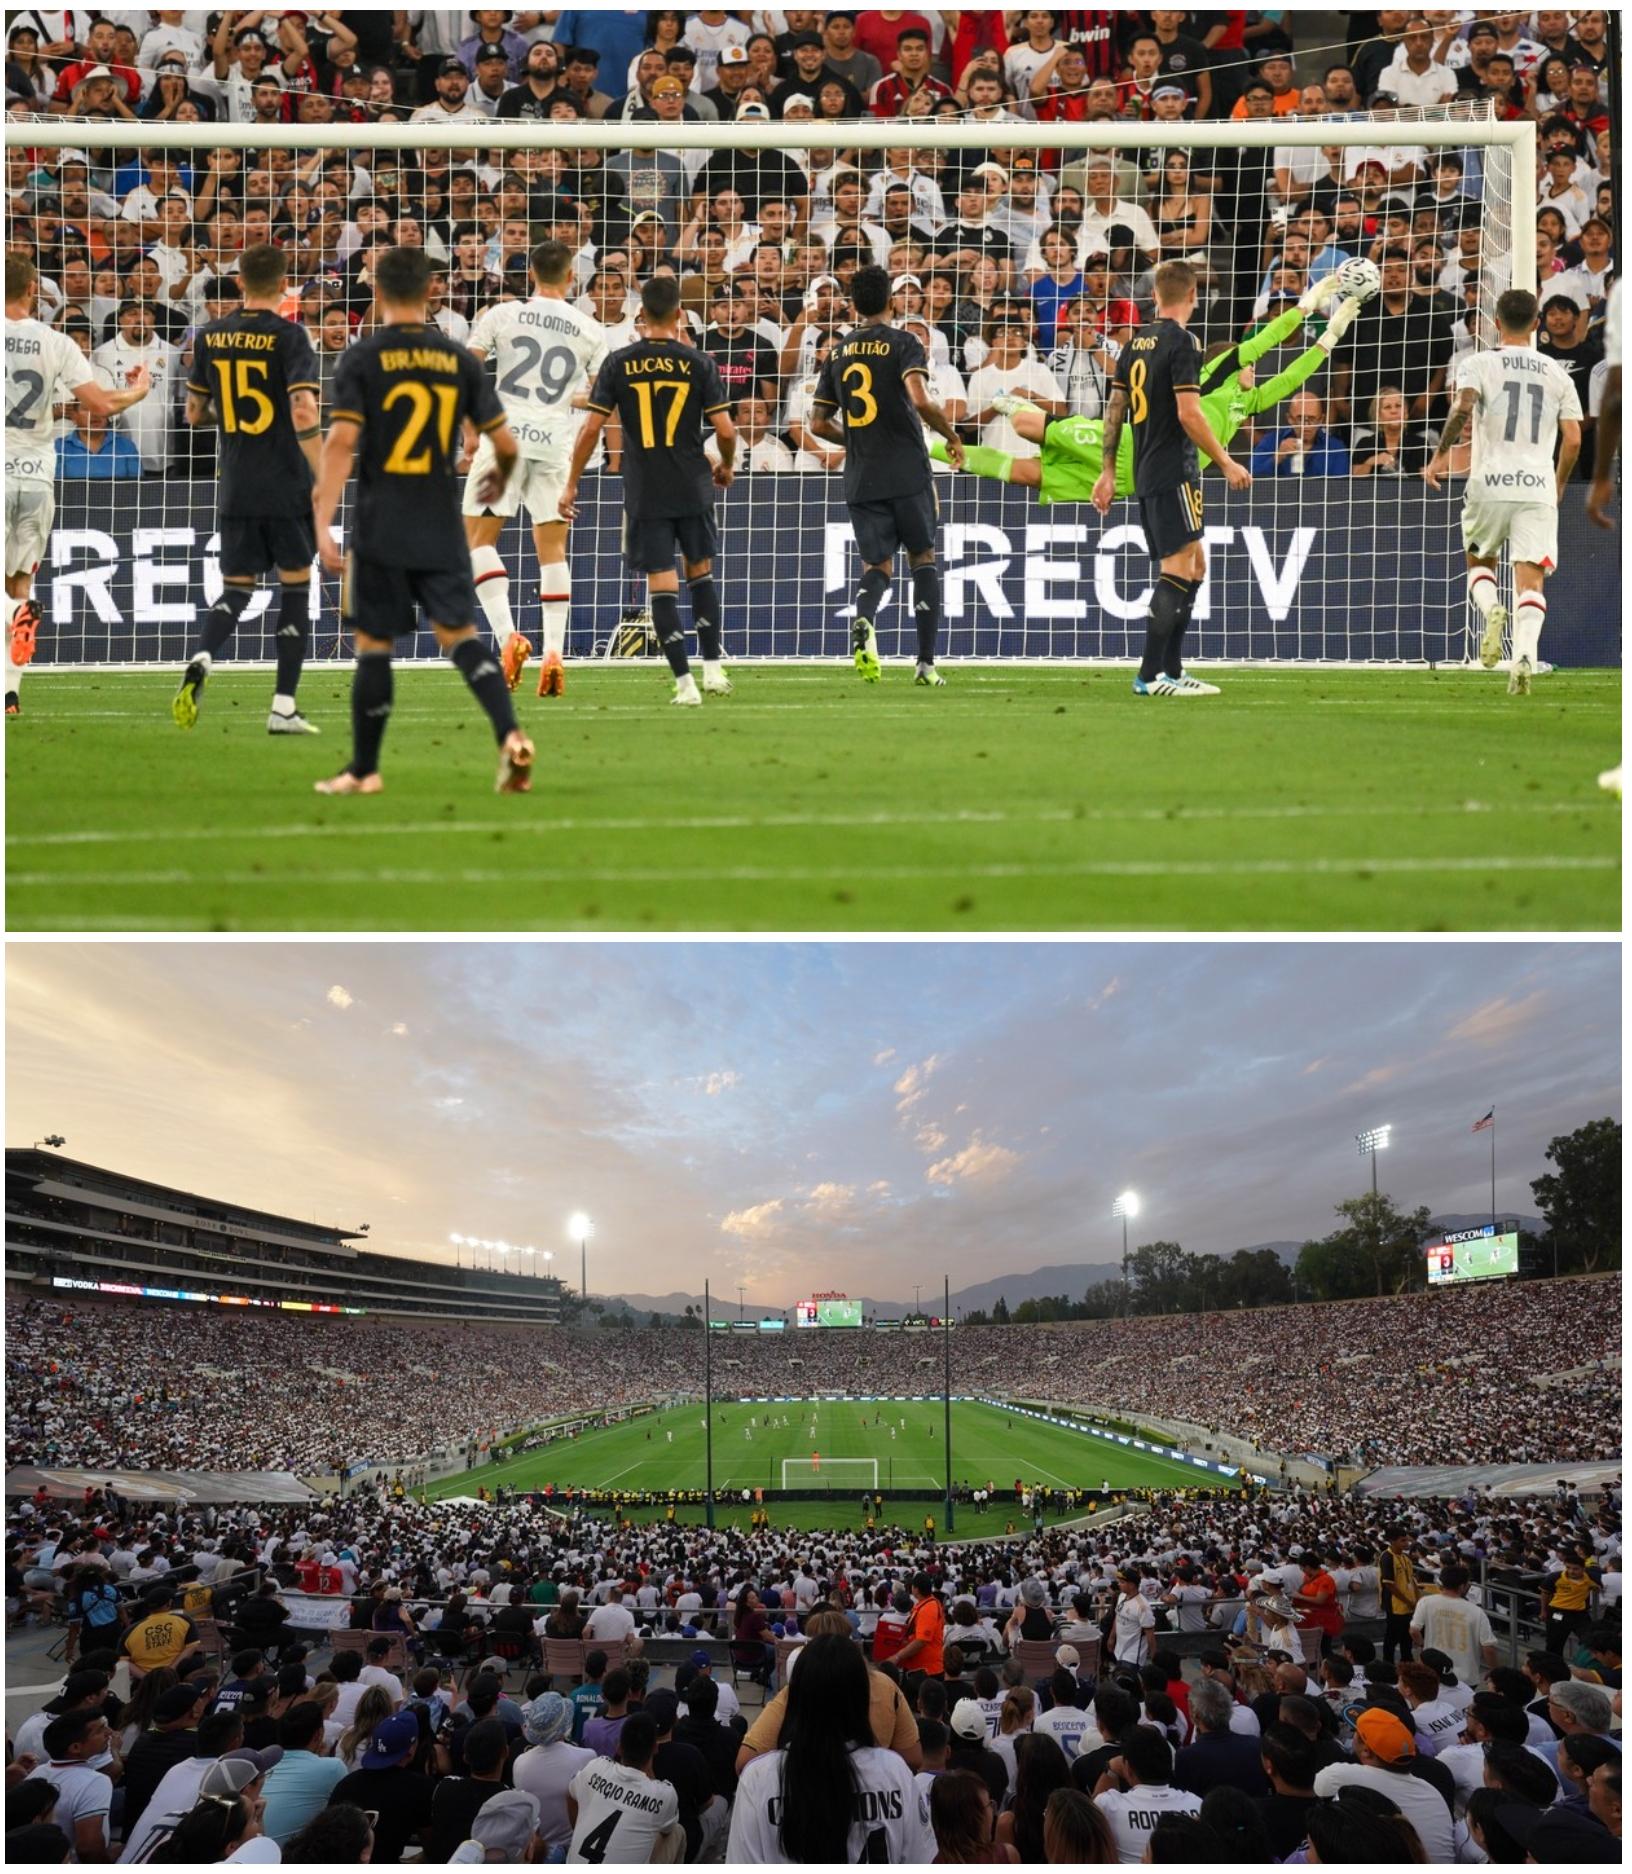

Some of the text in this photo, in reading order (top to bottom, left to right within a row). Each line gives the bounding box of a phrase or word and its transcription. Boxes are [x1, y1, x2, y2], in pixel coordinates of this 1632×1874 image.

[1069, 24, 1111, 43] bwin
[5, 336, 42, 356] BEGA
[205, 332, 277, 351] VALVERDE
[842, 339, 891, 358] MILITÃO
[498, 335, 577, 405] 29
[623, 358, 692, 376] LUCAS V.
[1501, 355, 1549, 377] PULISIC
[5, 365, 45, 430] 2
[212, 358, 275, 435] 15
[841, 362, 878, 428] 3
[1129, 357, 1148, 425] 8
[381, 380, 459, 475] 21
[629, 380, 691, 449] 17
[1502, 380, 1544, 445] 11
[511, 423, 553, 446] efox
[1484, 469, 1546, 489] wefox
[825, 521, 1317, 622] DRECTV
[1445, 1228, 1484, 1244] WESCOM
[71, 1280, 99, 1291] VODKA
[145, 1622, 173, 1636] CSC
[587, 1772, 664, 1815] SERGIO RAMOS
[578, 1809, 624, 1864] 4
